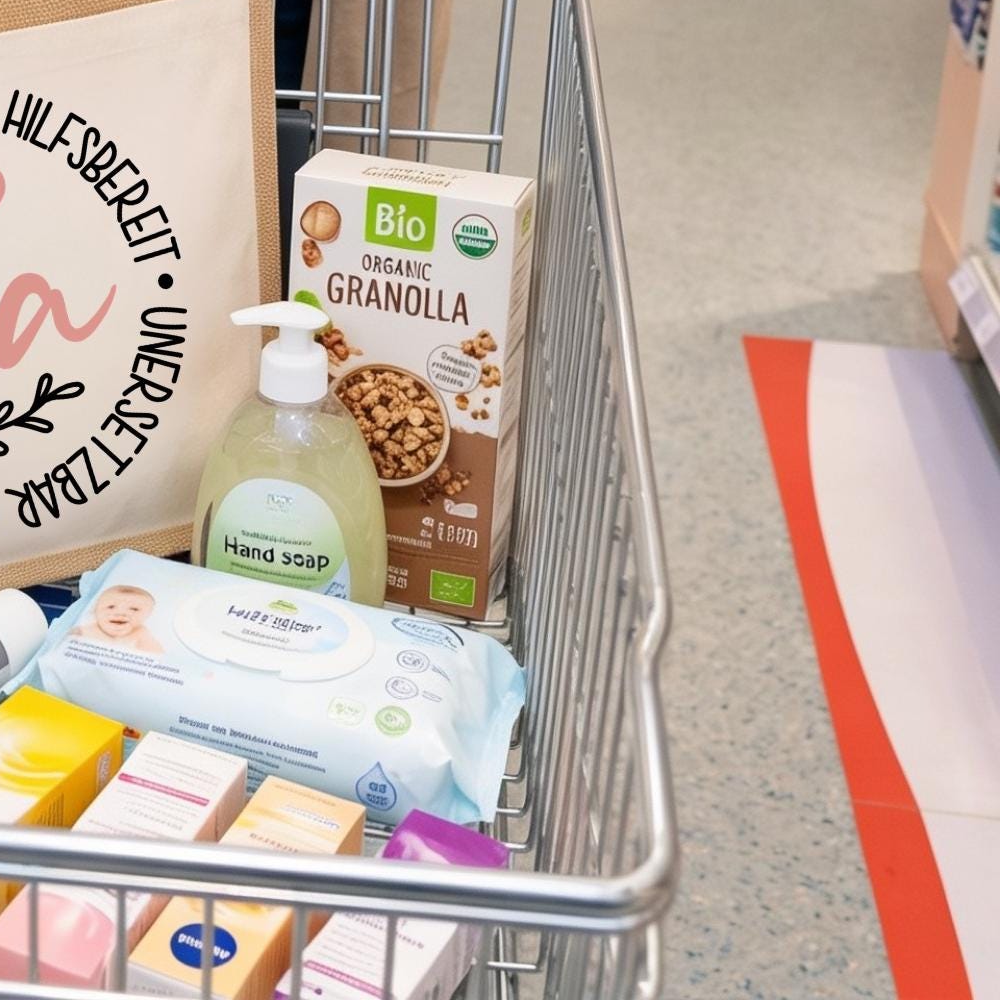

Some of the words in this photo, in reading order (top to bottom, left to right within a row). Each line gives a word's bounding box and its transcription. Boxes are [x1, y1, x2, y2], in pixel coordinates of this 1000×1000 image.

[1, 89, 181, 263] HILFSBEREIT
[375, 202, 426, 242] Bio
[362, 254, 432, 281] ORGANIC
[327, 272, 469, 326] GRANOLLA
[4, 306, 188, 529] UNERSETZBAR
[224, 534, 275, 563] Hand
[281, 551, 330, 572] soap
